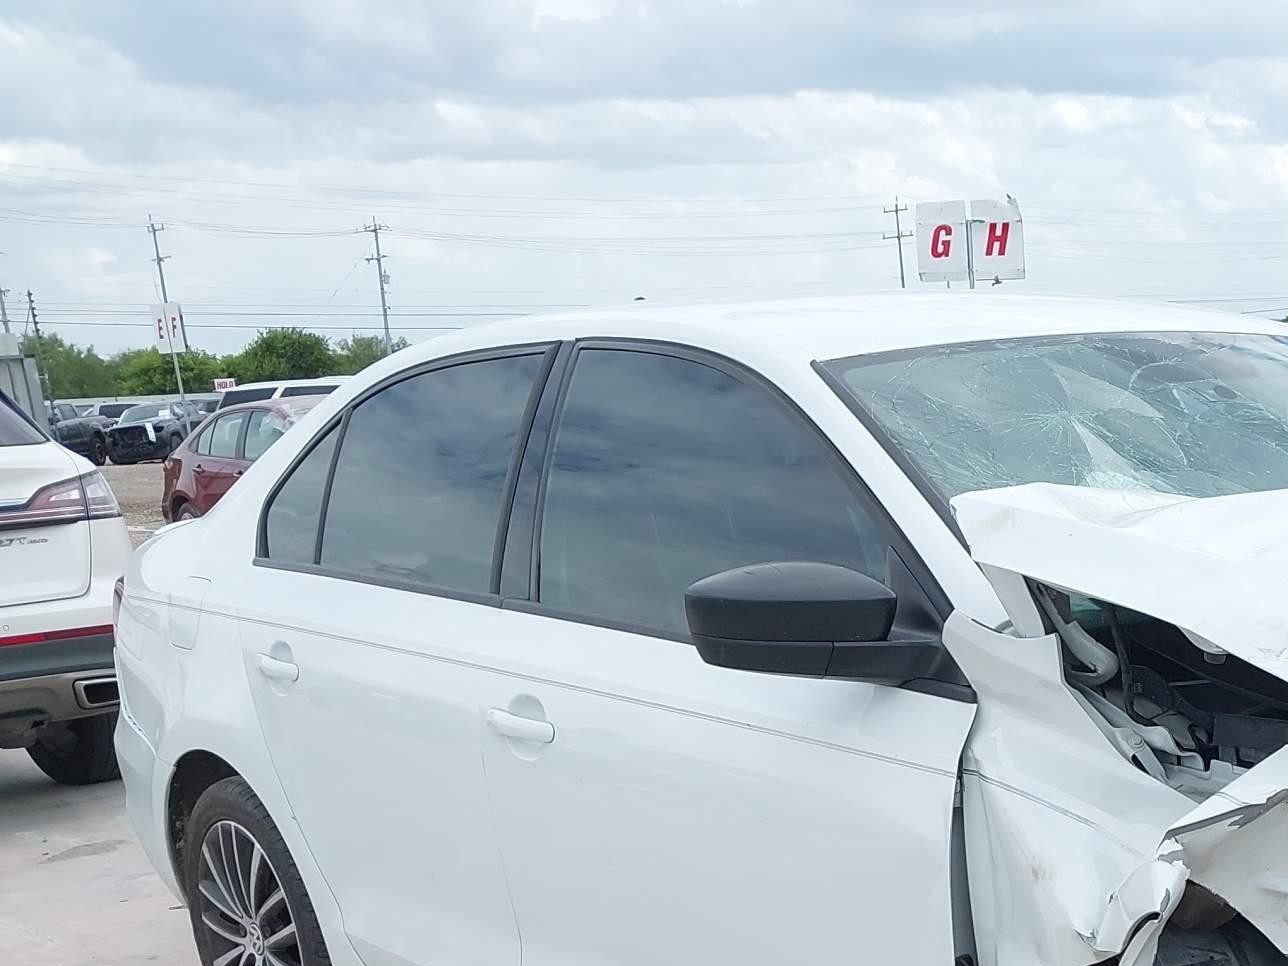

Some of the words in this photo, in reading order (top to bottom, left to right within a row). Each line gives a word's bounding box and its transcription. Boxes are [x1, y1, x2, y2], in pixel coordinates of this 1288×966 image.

[931, 224, 952, 258] G
[985, 222, 1010, 256] H
[157, 318, 164, 339] E
[171, 317, 177, 338] F
[217, 381, 234, 390] HOLD
